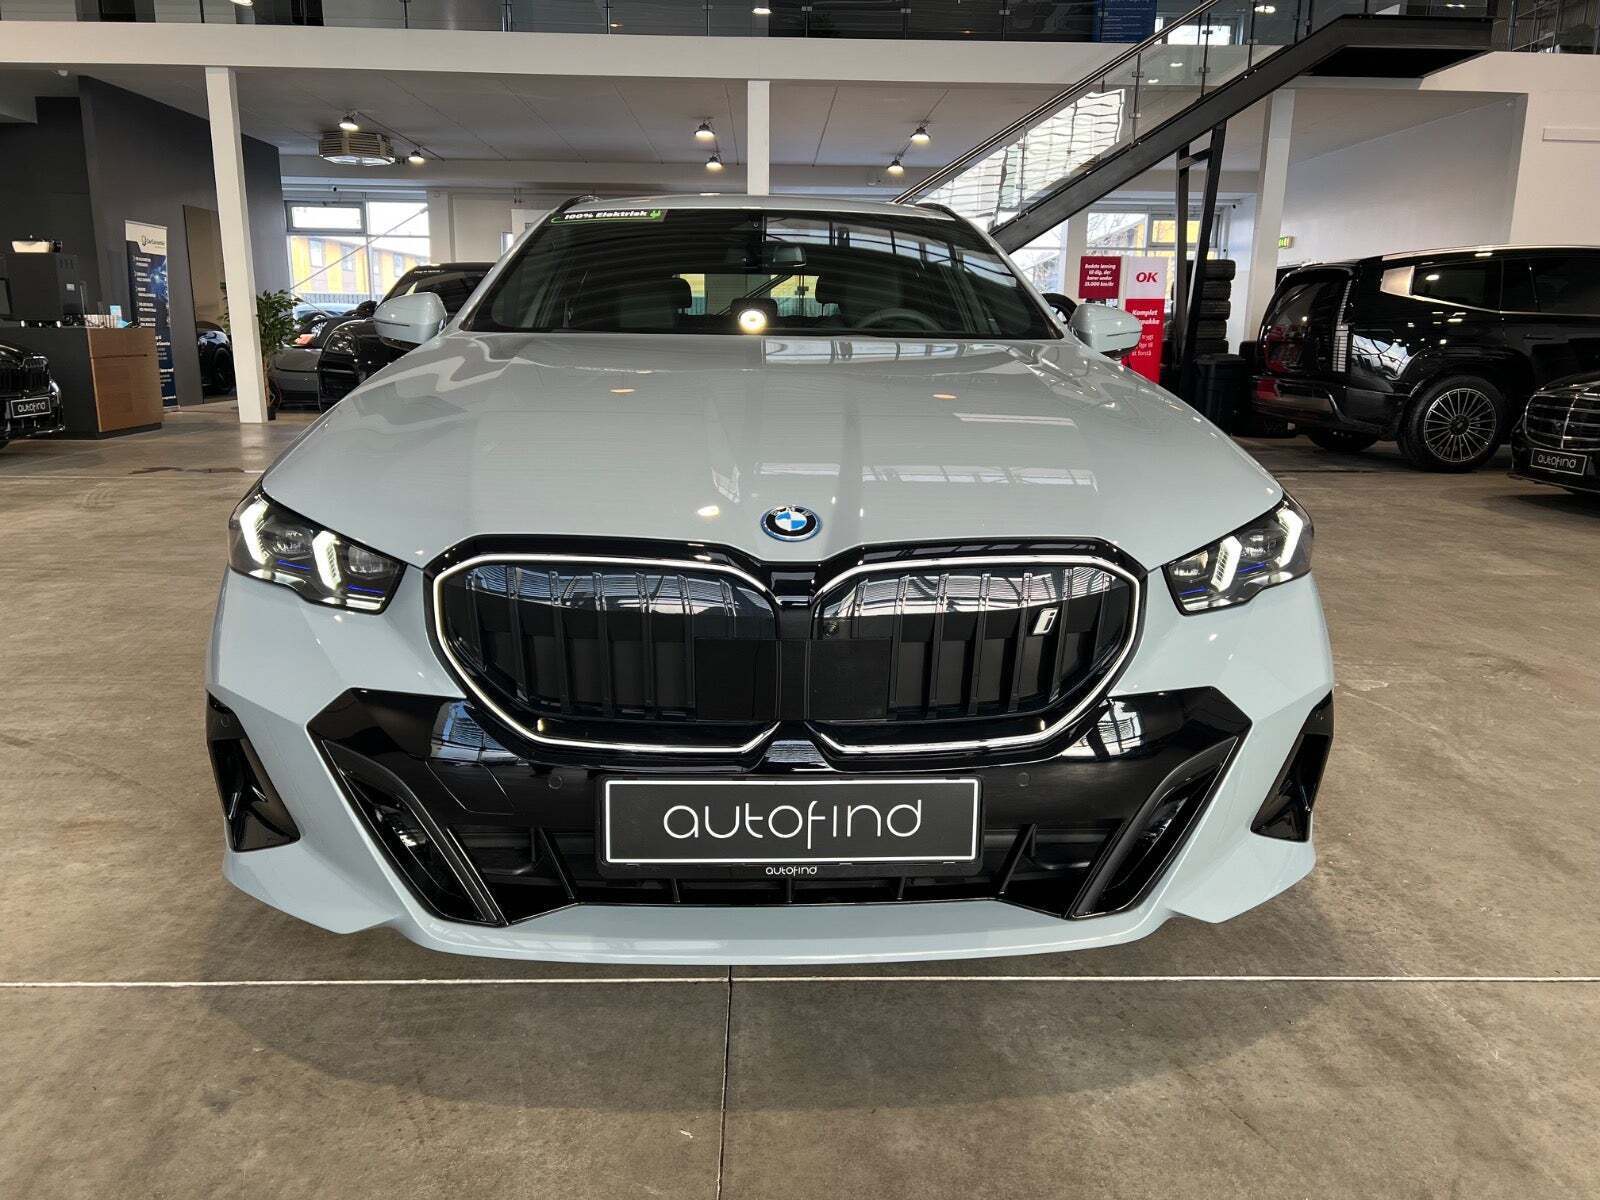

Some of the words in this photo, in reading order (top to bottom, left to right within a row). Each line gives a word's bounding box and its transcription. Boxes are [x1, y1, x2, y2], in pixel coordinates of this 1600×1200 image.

[1136, 272, 1158, 282] OK
[1132, 309, 1158, 317] Komplet
[1538, 455, 1576, 468] autofind
[664, 800, 923, 849] autofind
[765, 865, 817, 877] autofind
